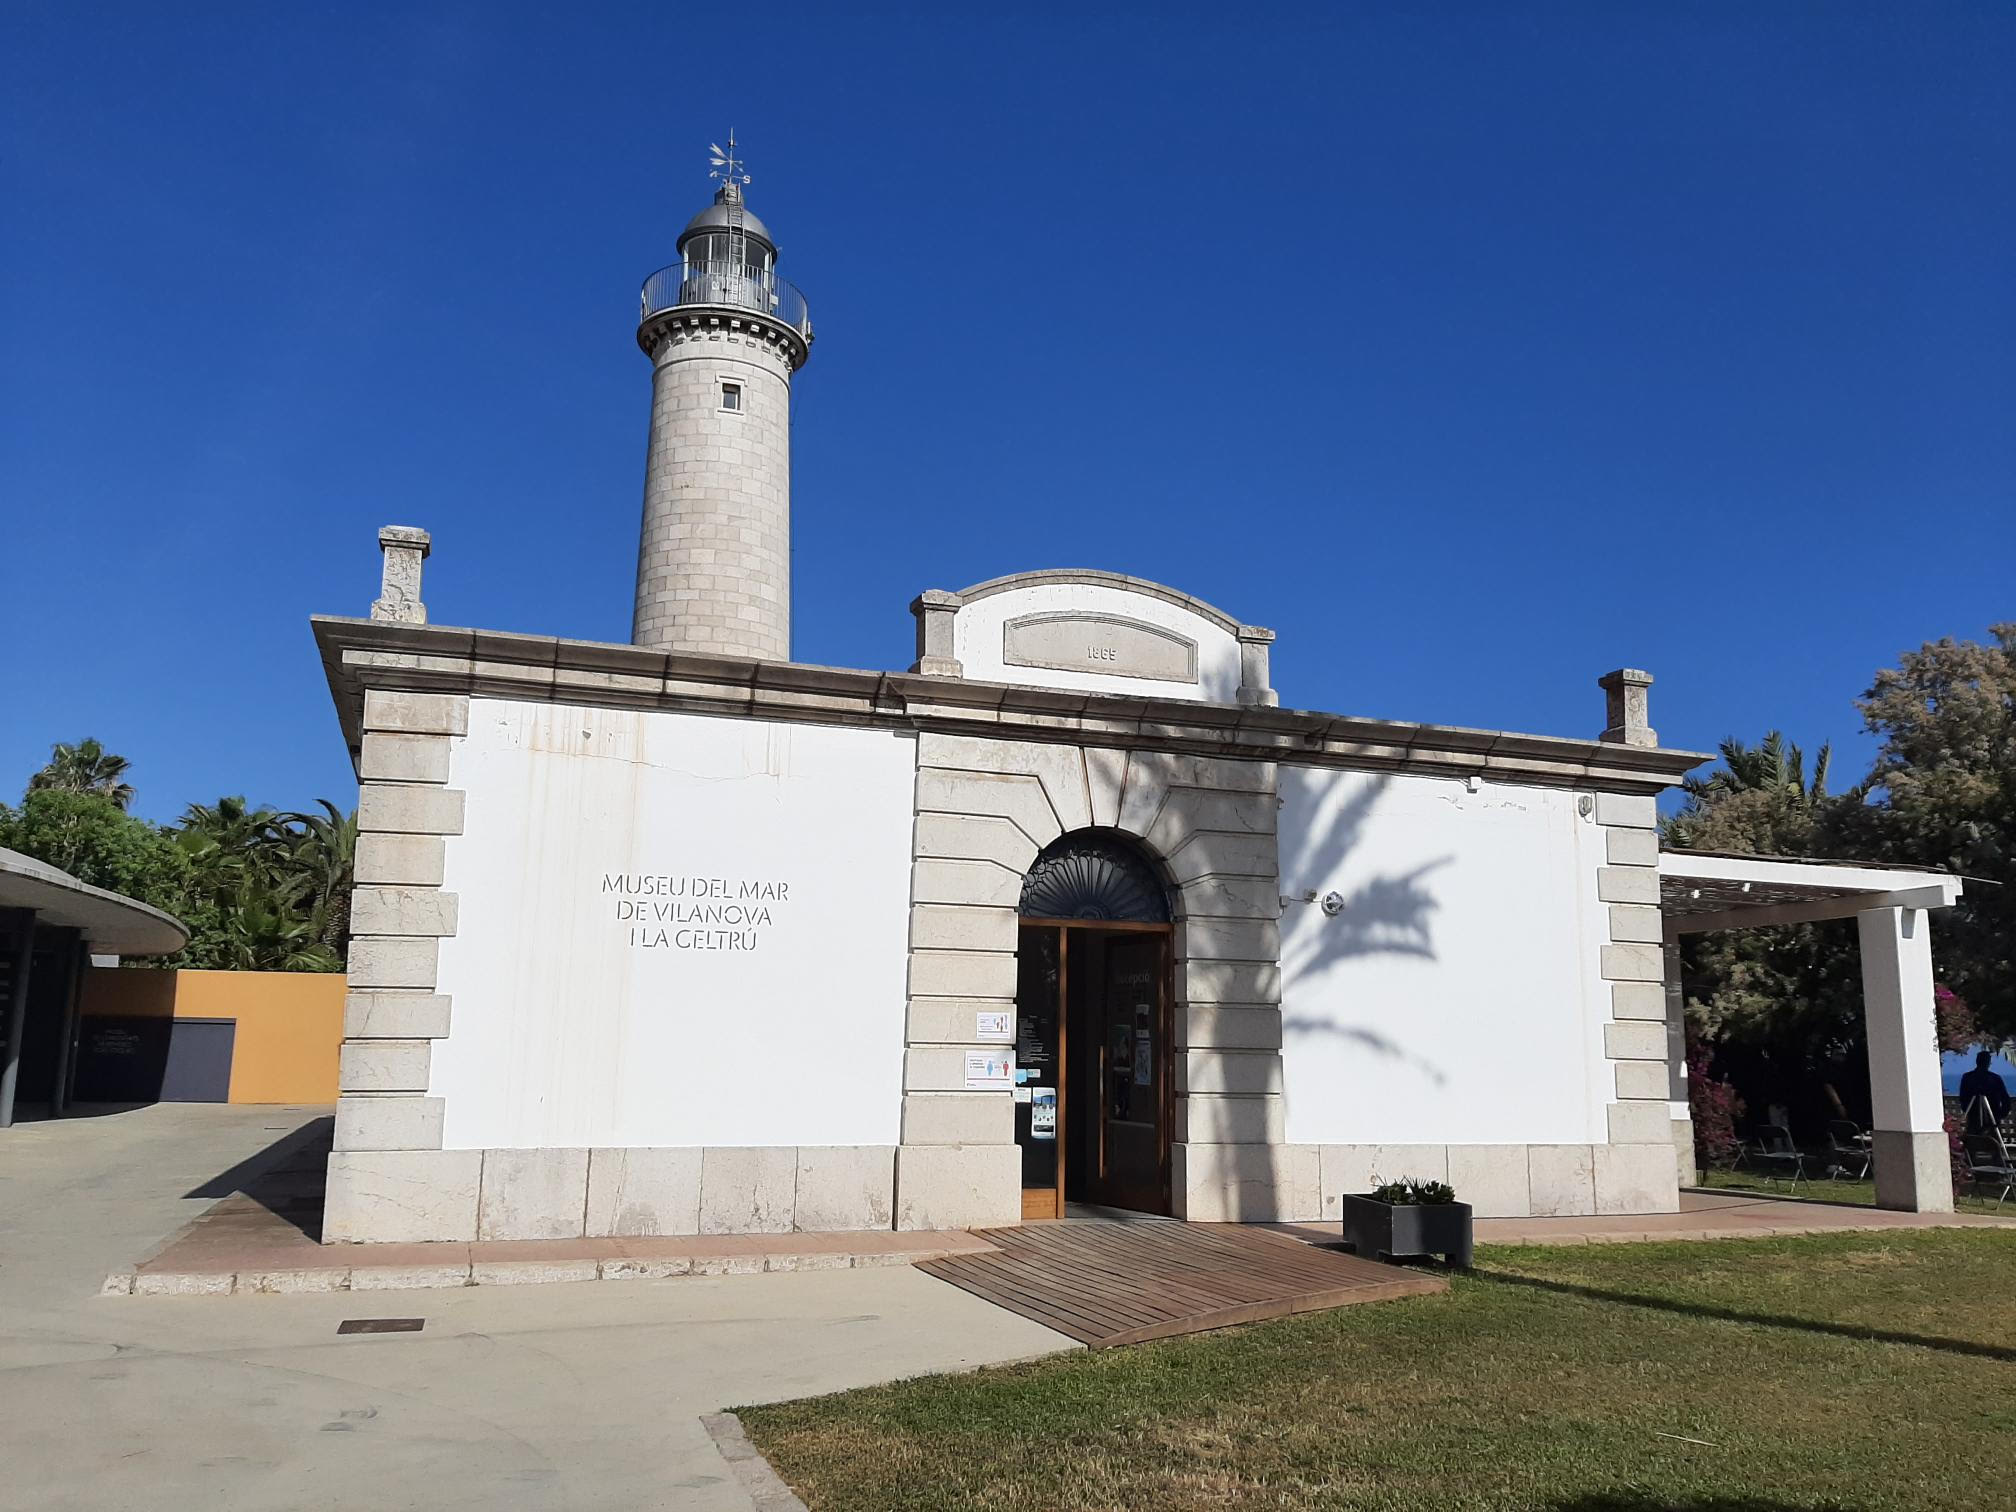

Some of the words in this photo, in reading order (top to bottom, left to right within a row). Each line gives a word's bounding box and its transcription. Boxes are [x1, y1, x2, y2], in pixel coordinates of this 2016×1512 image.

[602, 874, 685, 896] MUSEU
[692, 878, 733, 899] DEL
[739, 880, 789, 902] MAR
[616, 900, 648, 921] DE
[653, 902, 772, 927] VILANOVA
[630, 927, 635, 947] I
[642, 927, 669, 948] LA
